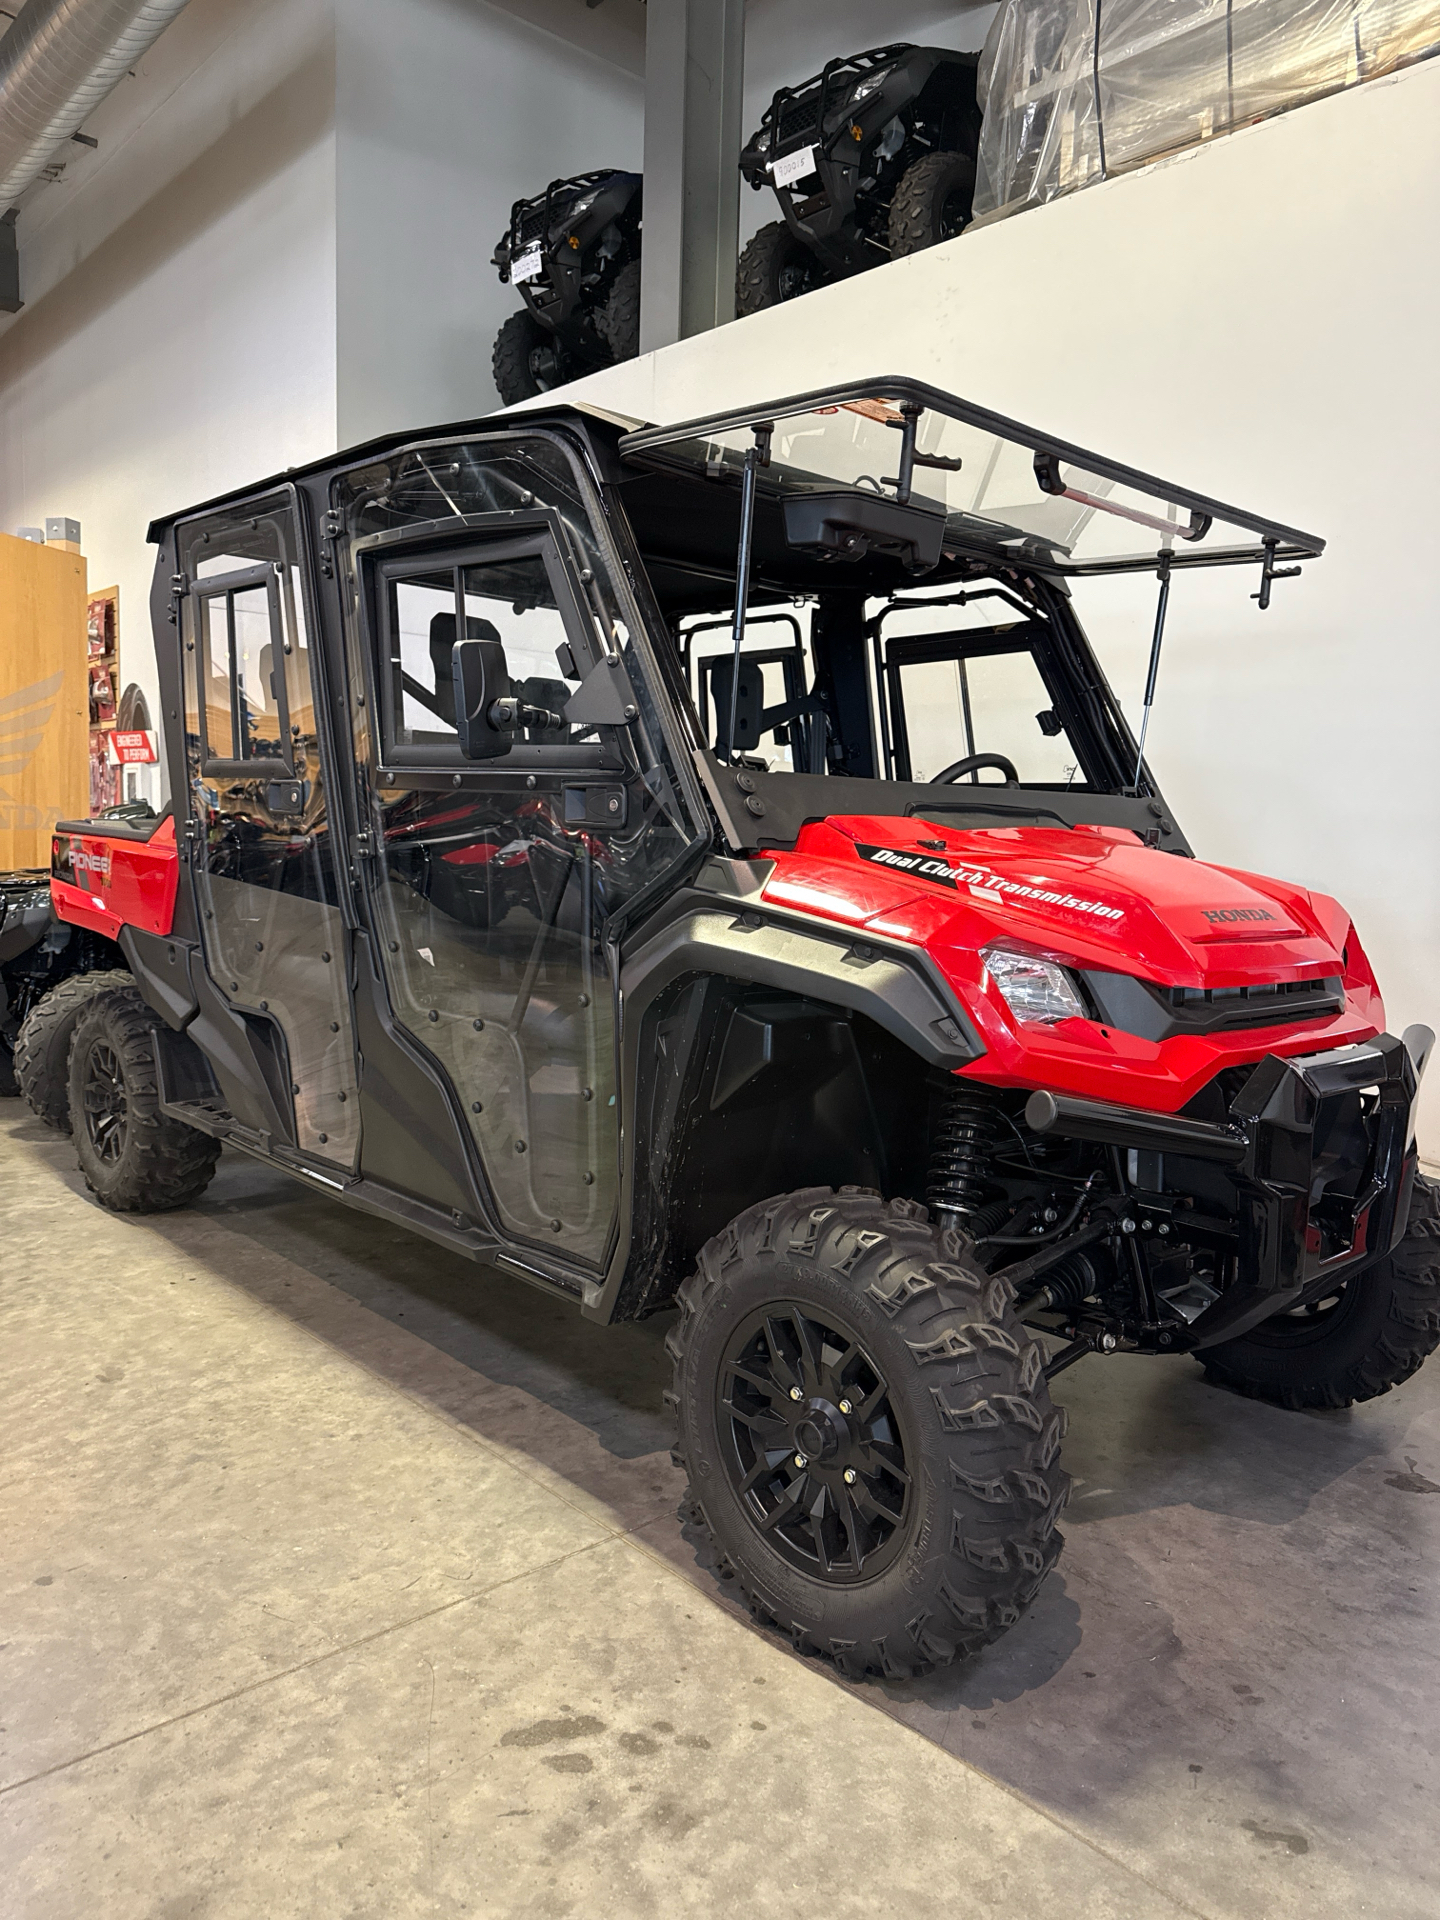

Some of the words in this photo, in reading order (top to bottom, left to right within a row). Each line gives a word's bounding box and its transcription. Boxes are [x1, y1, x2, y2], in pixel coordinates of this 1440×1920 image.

[870, 849, 914, 869] Dual
[918, 860, 984, 885] Clutch
[986, 876, 1125, 920] Transmission
[1200, 908, 1278, 923] HONDA
